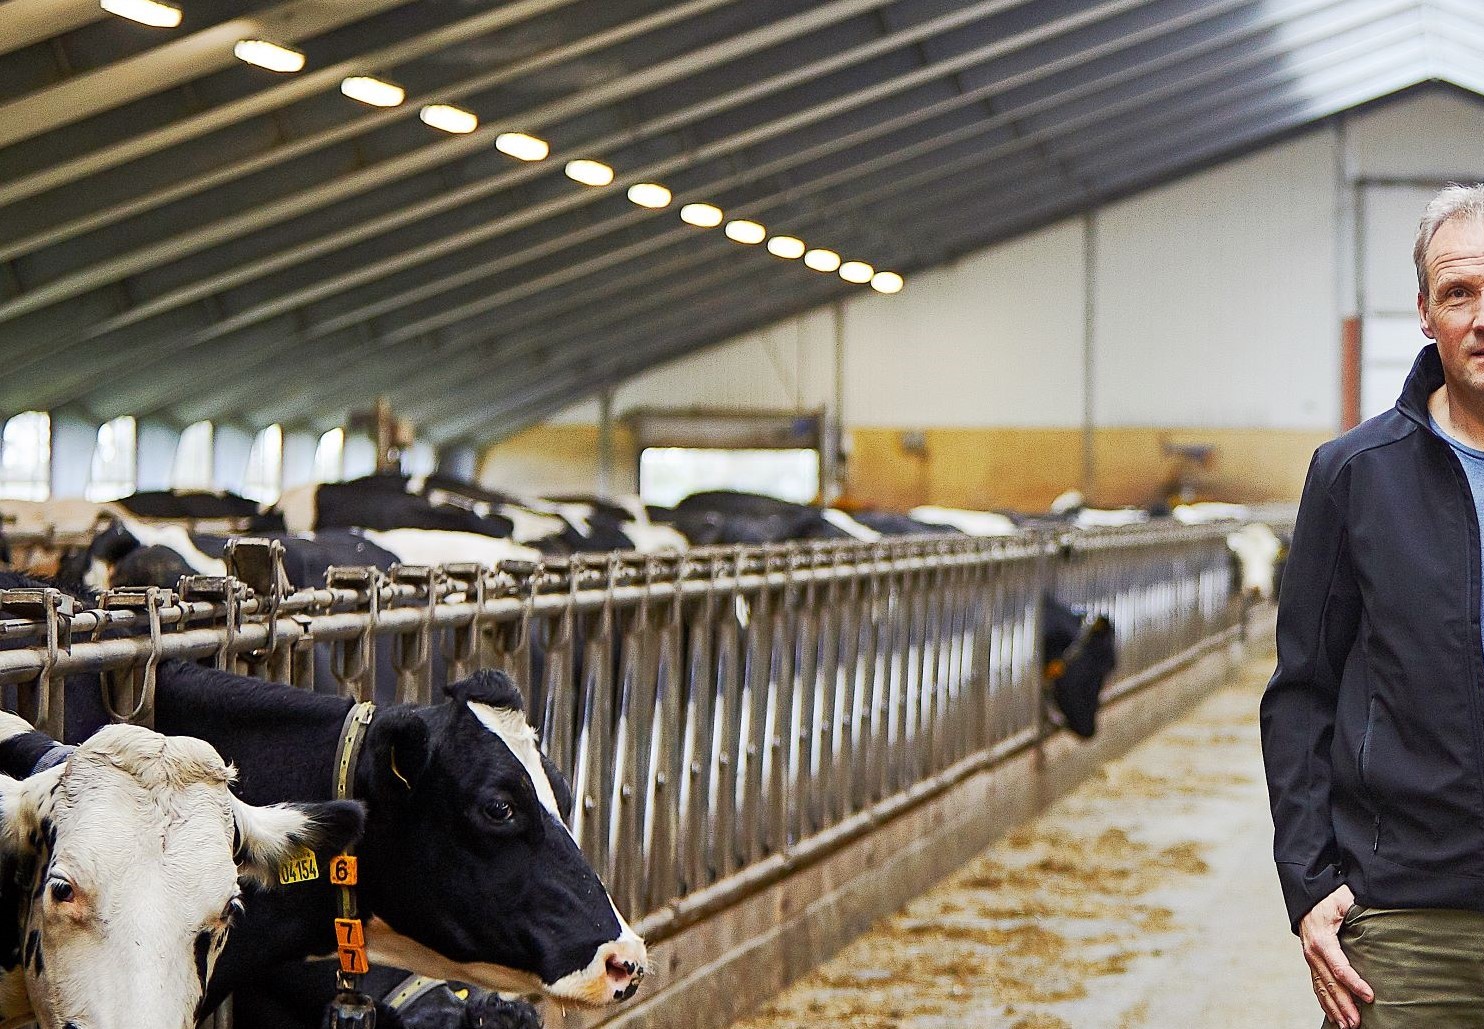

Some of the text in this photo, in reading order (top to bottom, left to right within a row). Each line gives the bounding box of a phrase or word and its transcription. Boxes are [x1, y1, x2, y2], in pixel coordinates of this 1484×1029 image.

[281, 859, 317, 883] 04154
[335, 860, 349, 881] 6
[339, 922, 353, 944] 7
[343, 948, 356, 971] 7
